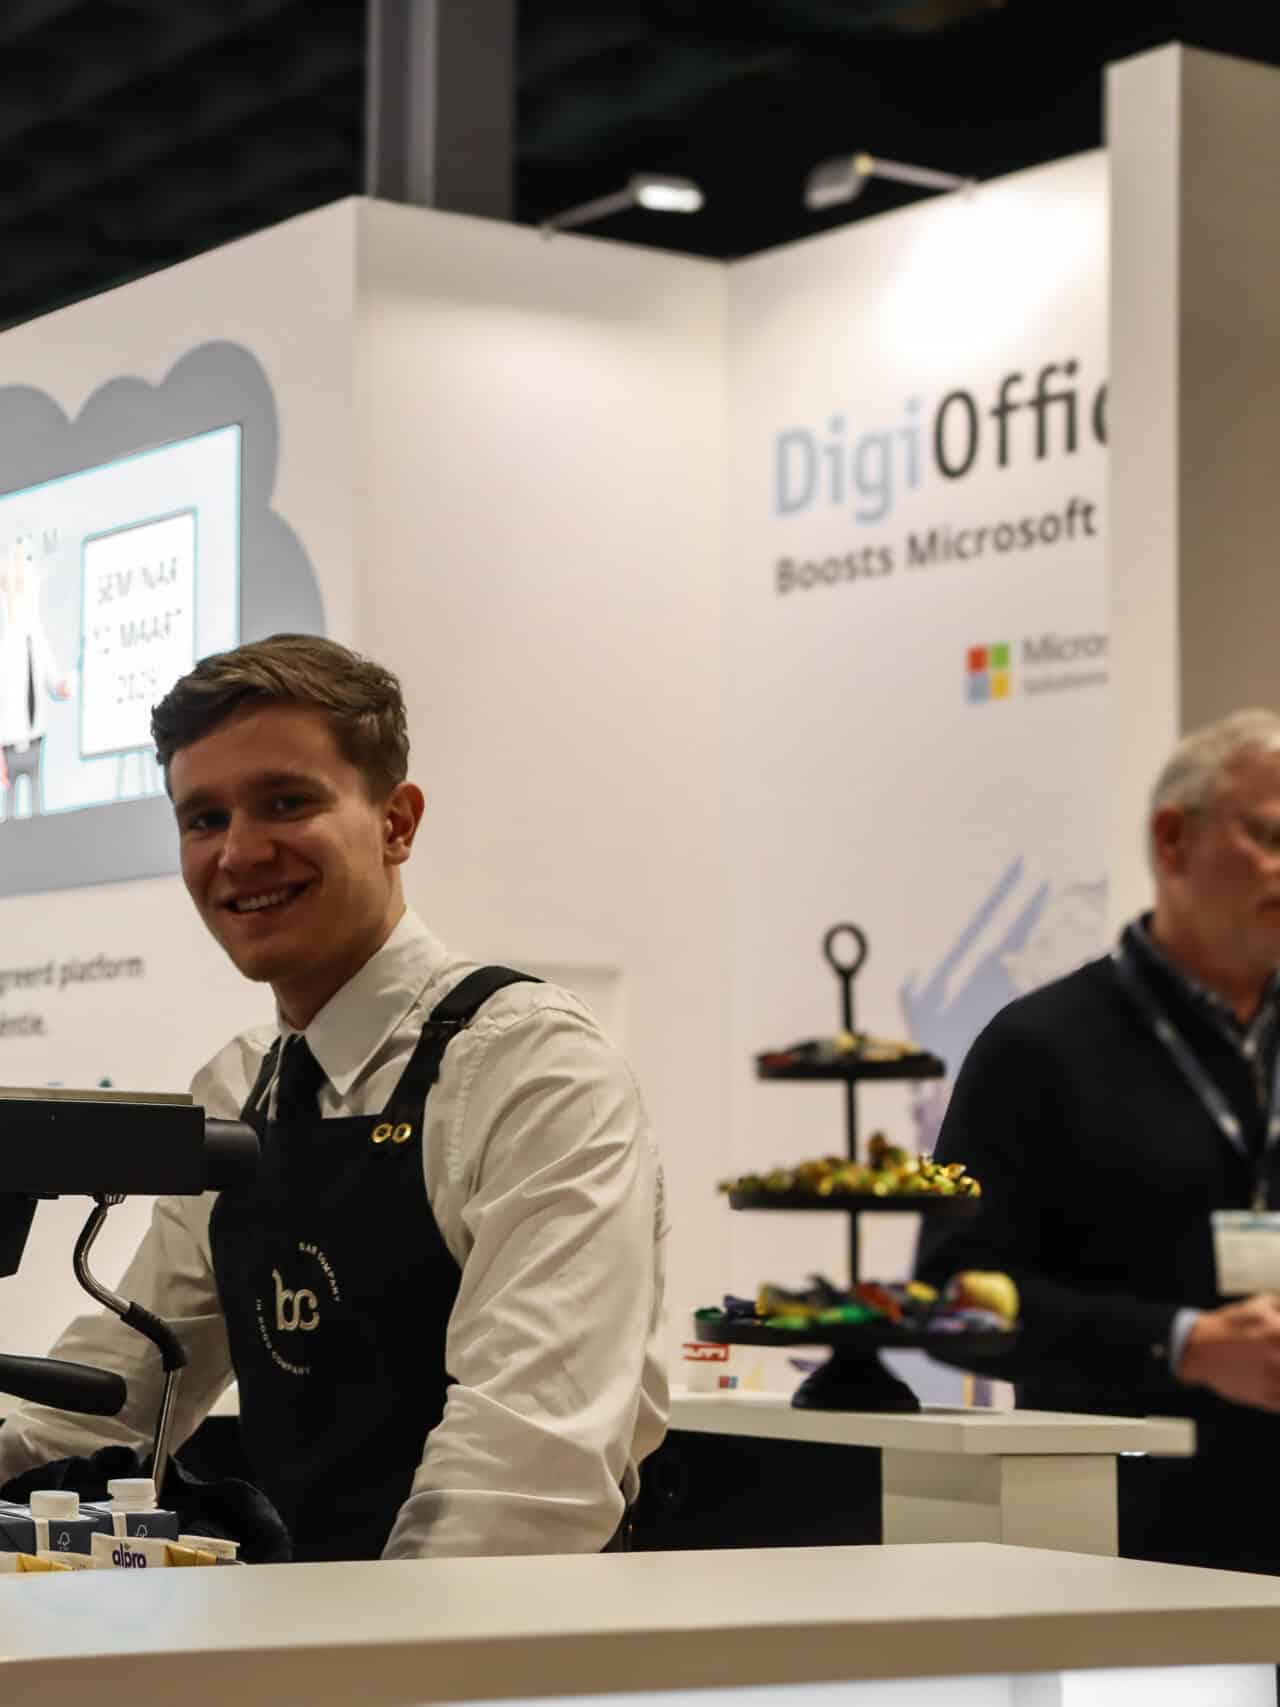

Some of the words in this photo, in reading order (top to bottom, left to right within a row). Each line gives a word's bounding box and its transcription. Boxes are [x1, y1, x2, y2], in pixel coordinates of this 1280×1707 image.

[776, 546, 894, 596] Boosts
[907, 497, 1097, 568] Microsoft
[59, 953, 145, 992] platform
[271, 1267, 320, 1331] bc
[111, 1542, 147, 1568] alpro
